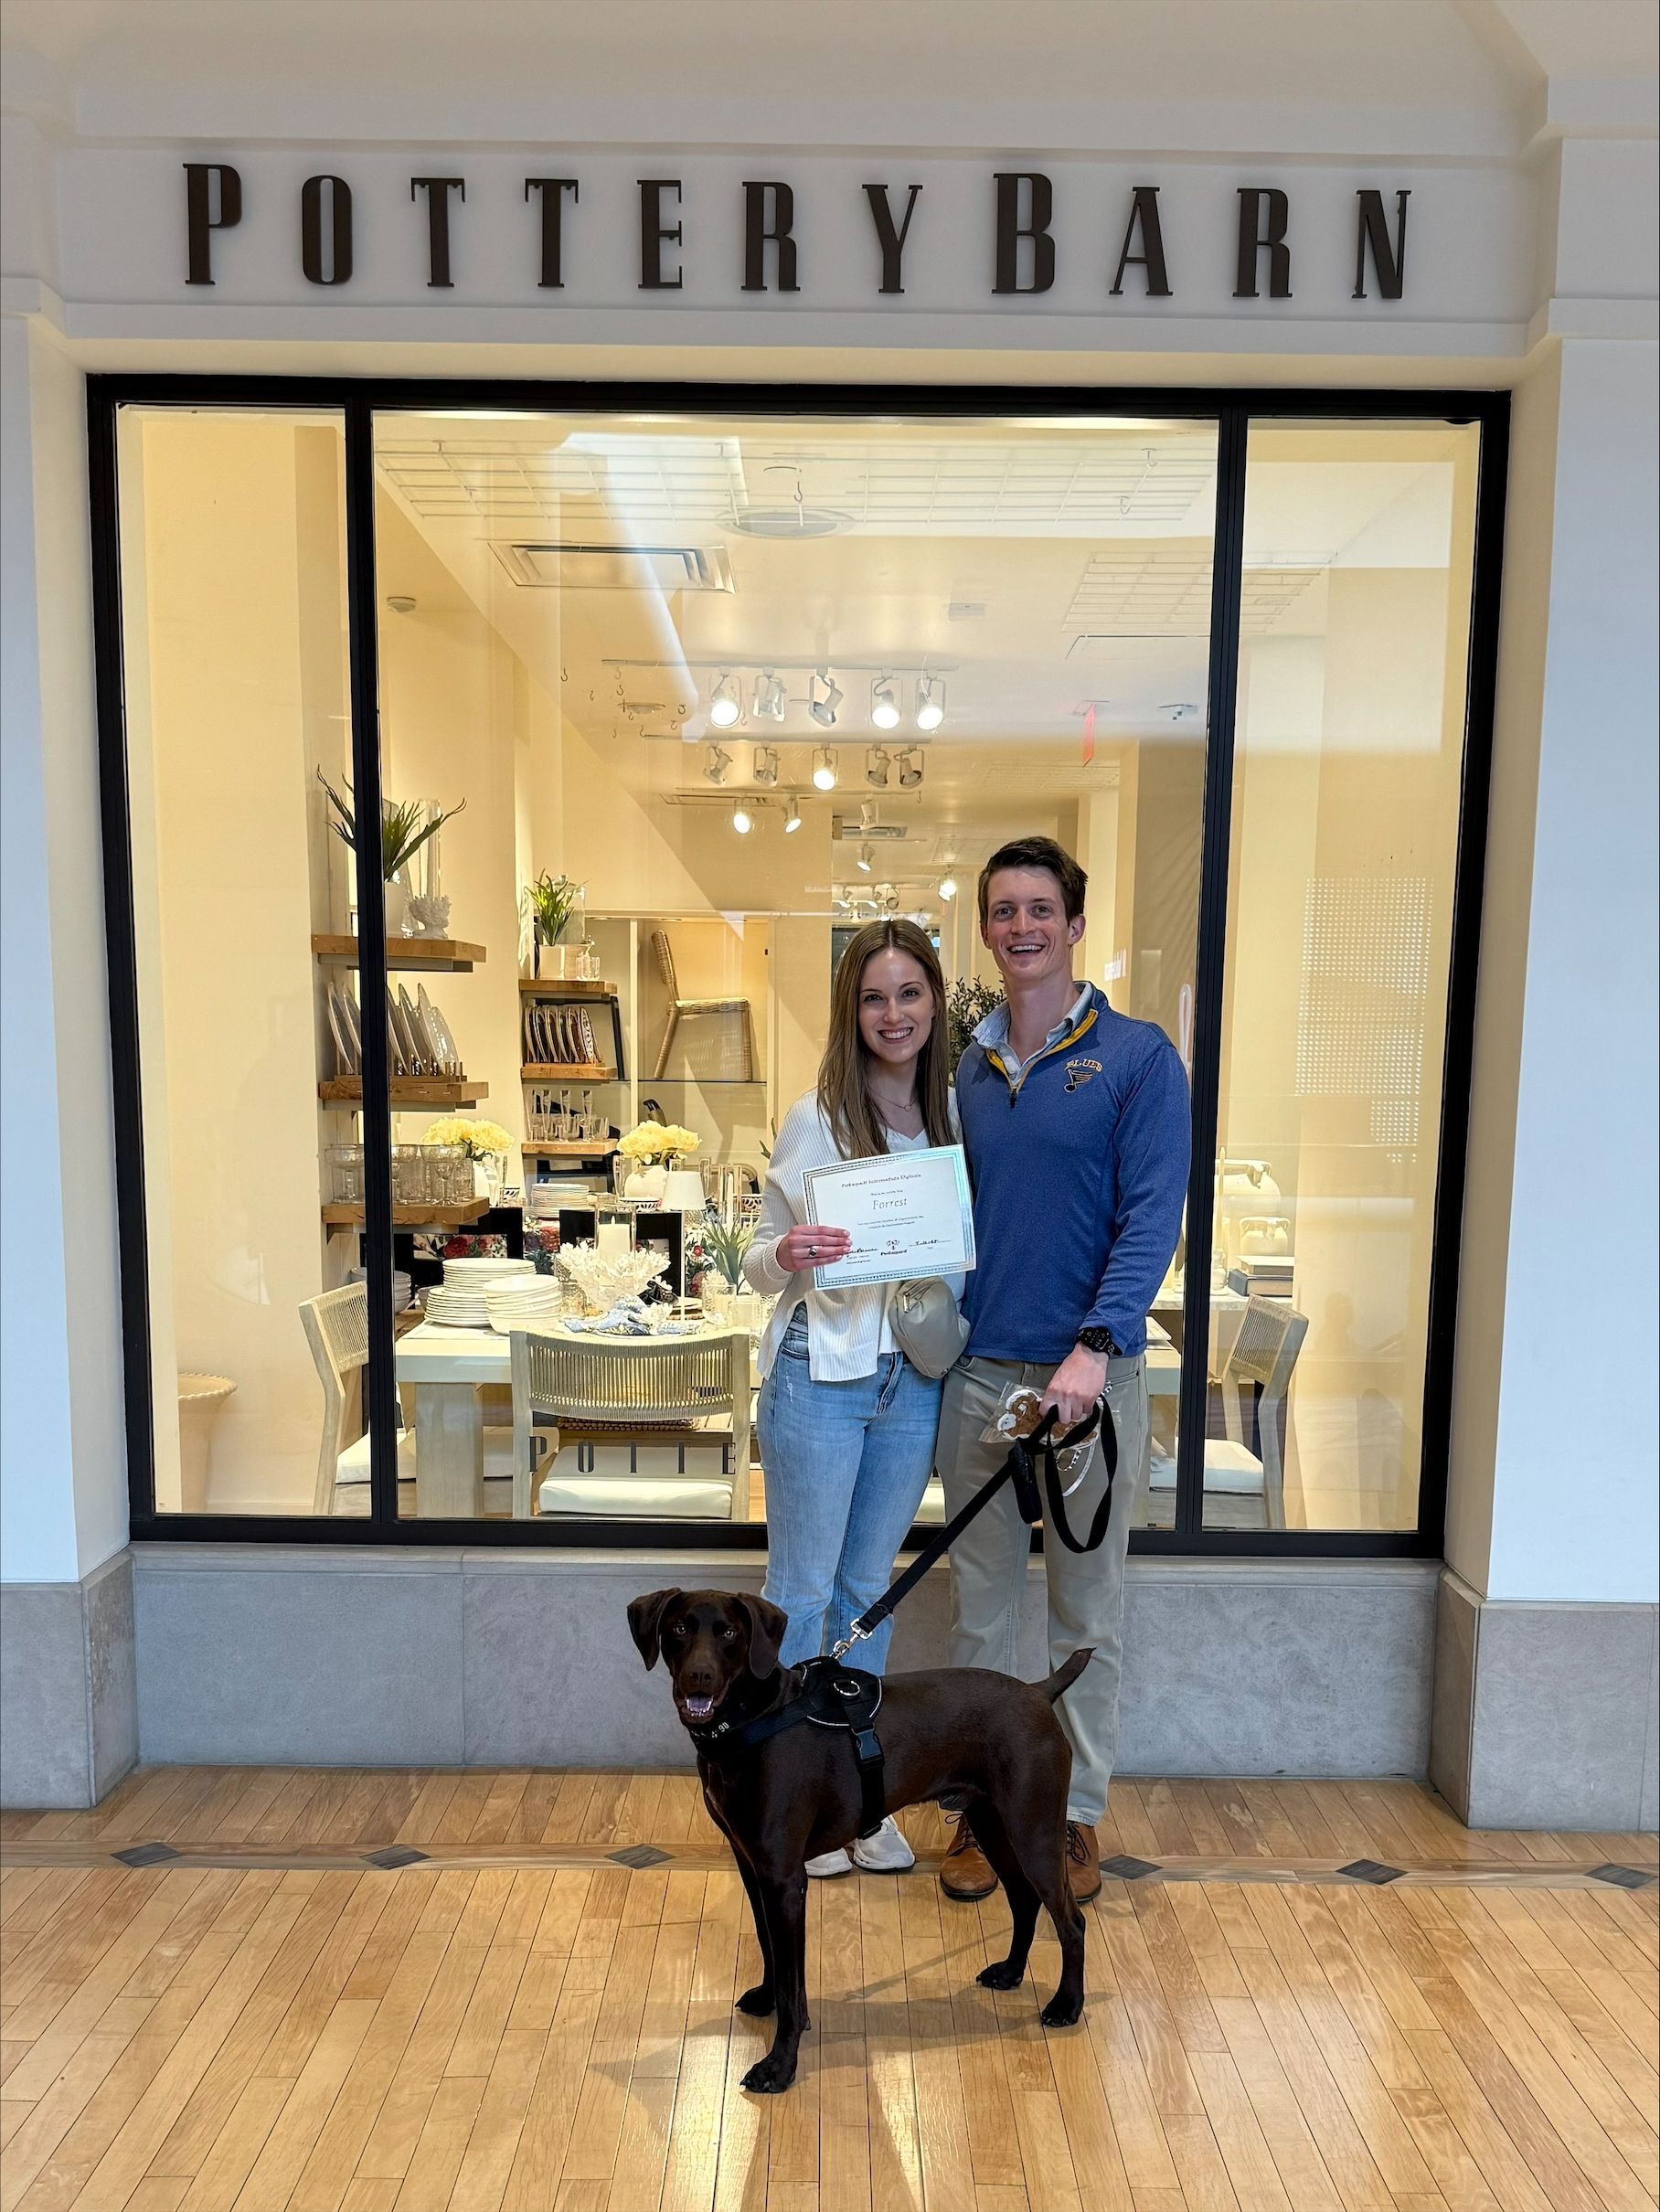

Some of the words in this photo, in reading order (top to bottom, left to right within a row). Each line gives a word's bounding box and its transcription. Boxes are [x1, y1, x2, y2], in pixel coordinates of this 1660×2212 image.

[183, 164, 923, 294] POTTERY
[992, 174, 1413, 300] BARN
[873, 1198, 907, 1210] Forrest
[528, 1436, 736, 1474] POTTE
